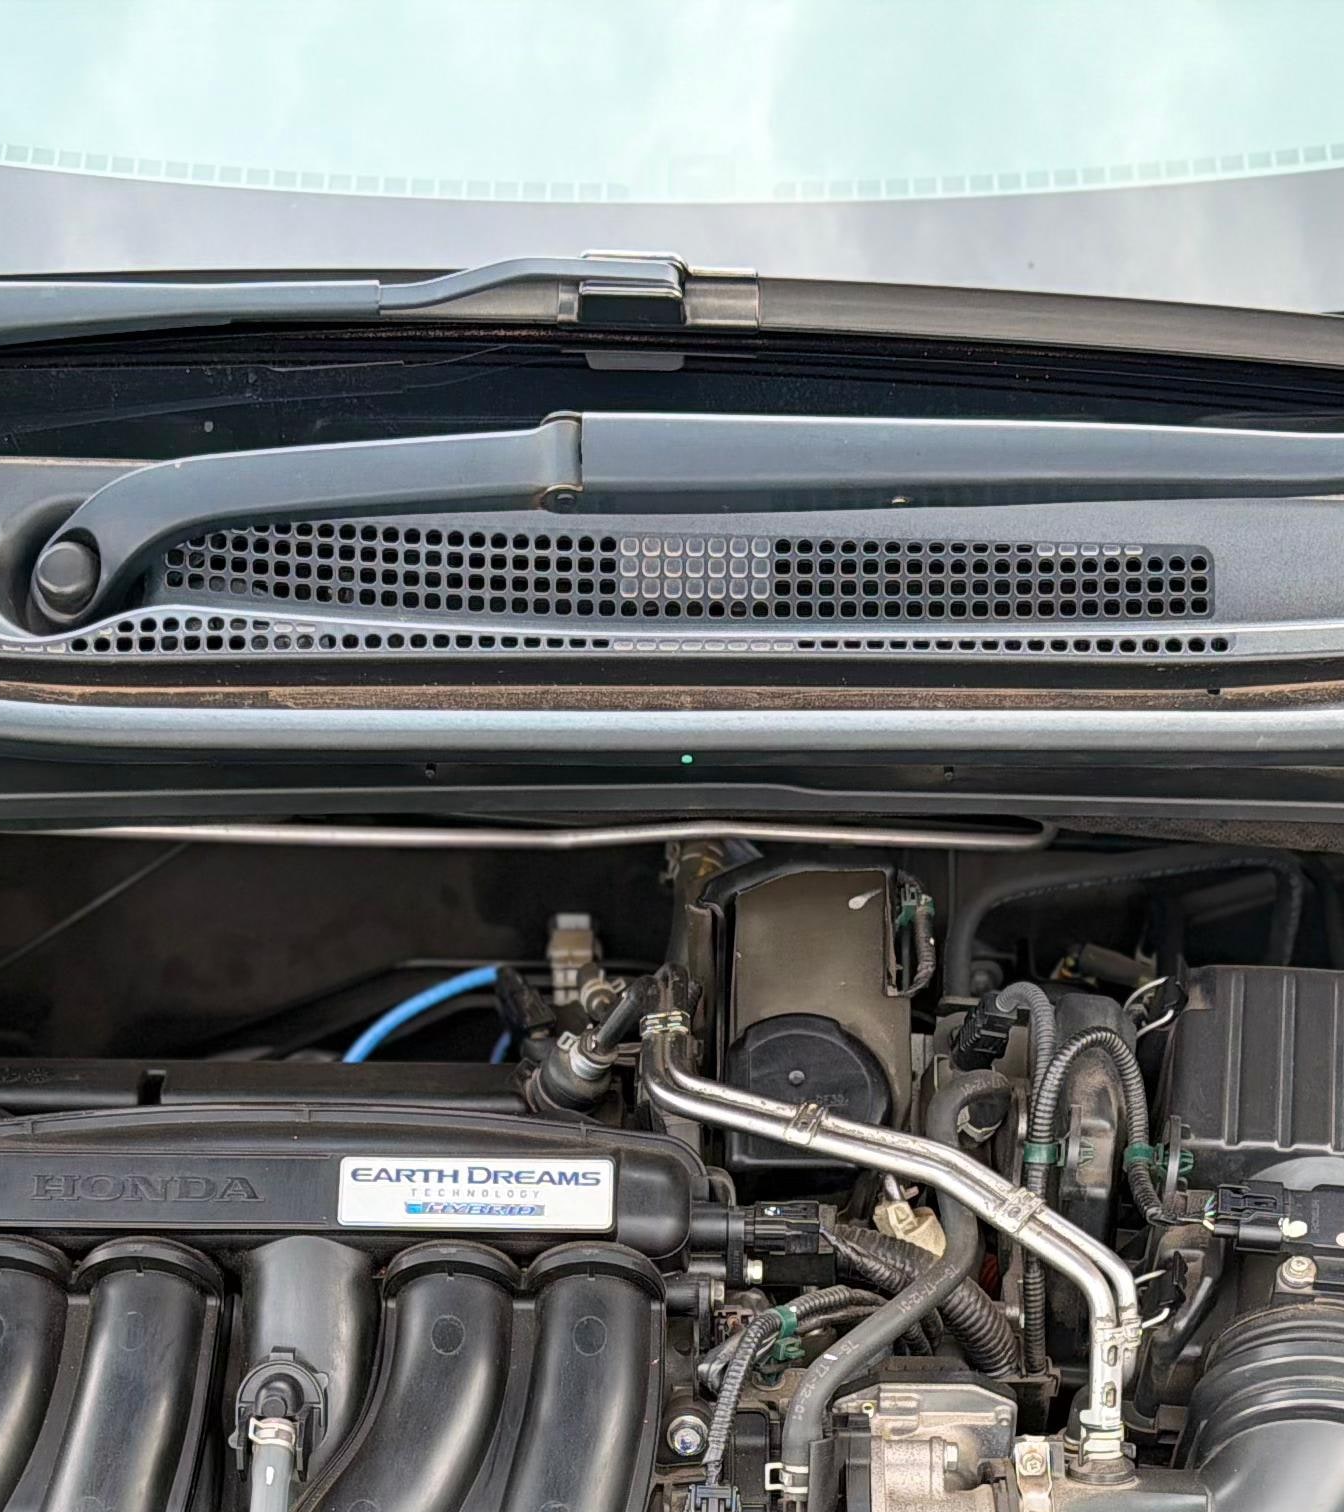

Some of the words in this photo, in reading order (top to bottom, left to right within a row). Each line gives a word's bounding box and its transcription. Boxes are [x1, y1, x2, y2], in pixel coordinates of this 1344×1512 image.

[350, 1167, 459, 1185] EARTH
[467, 1166, 602, 1187] DREAMS
[30, 1173, 265, 1203] HONDA
[410, 1187, 542, 1199] TECHNOLOGY
[425, 1202, 537, 1217] HYBRID
